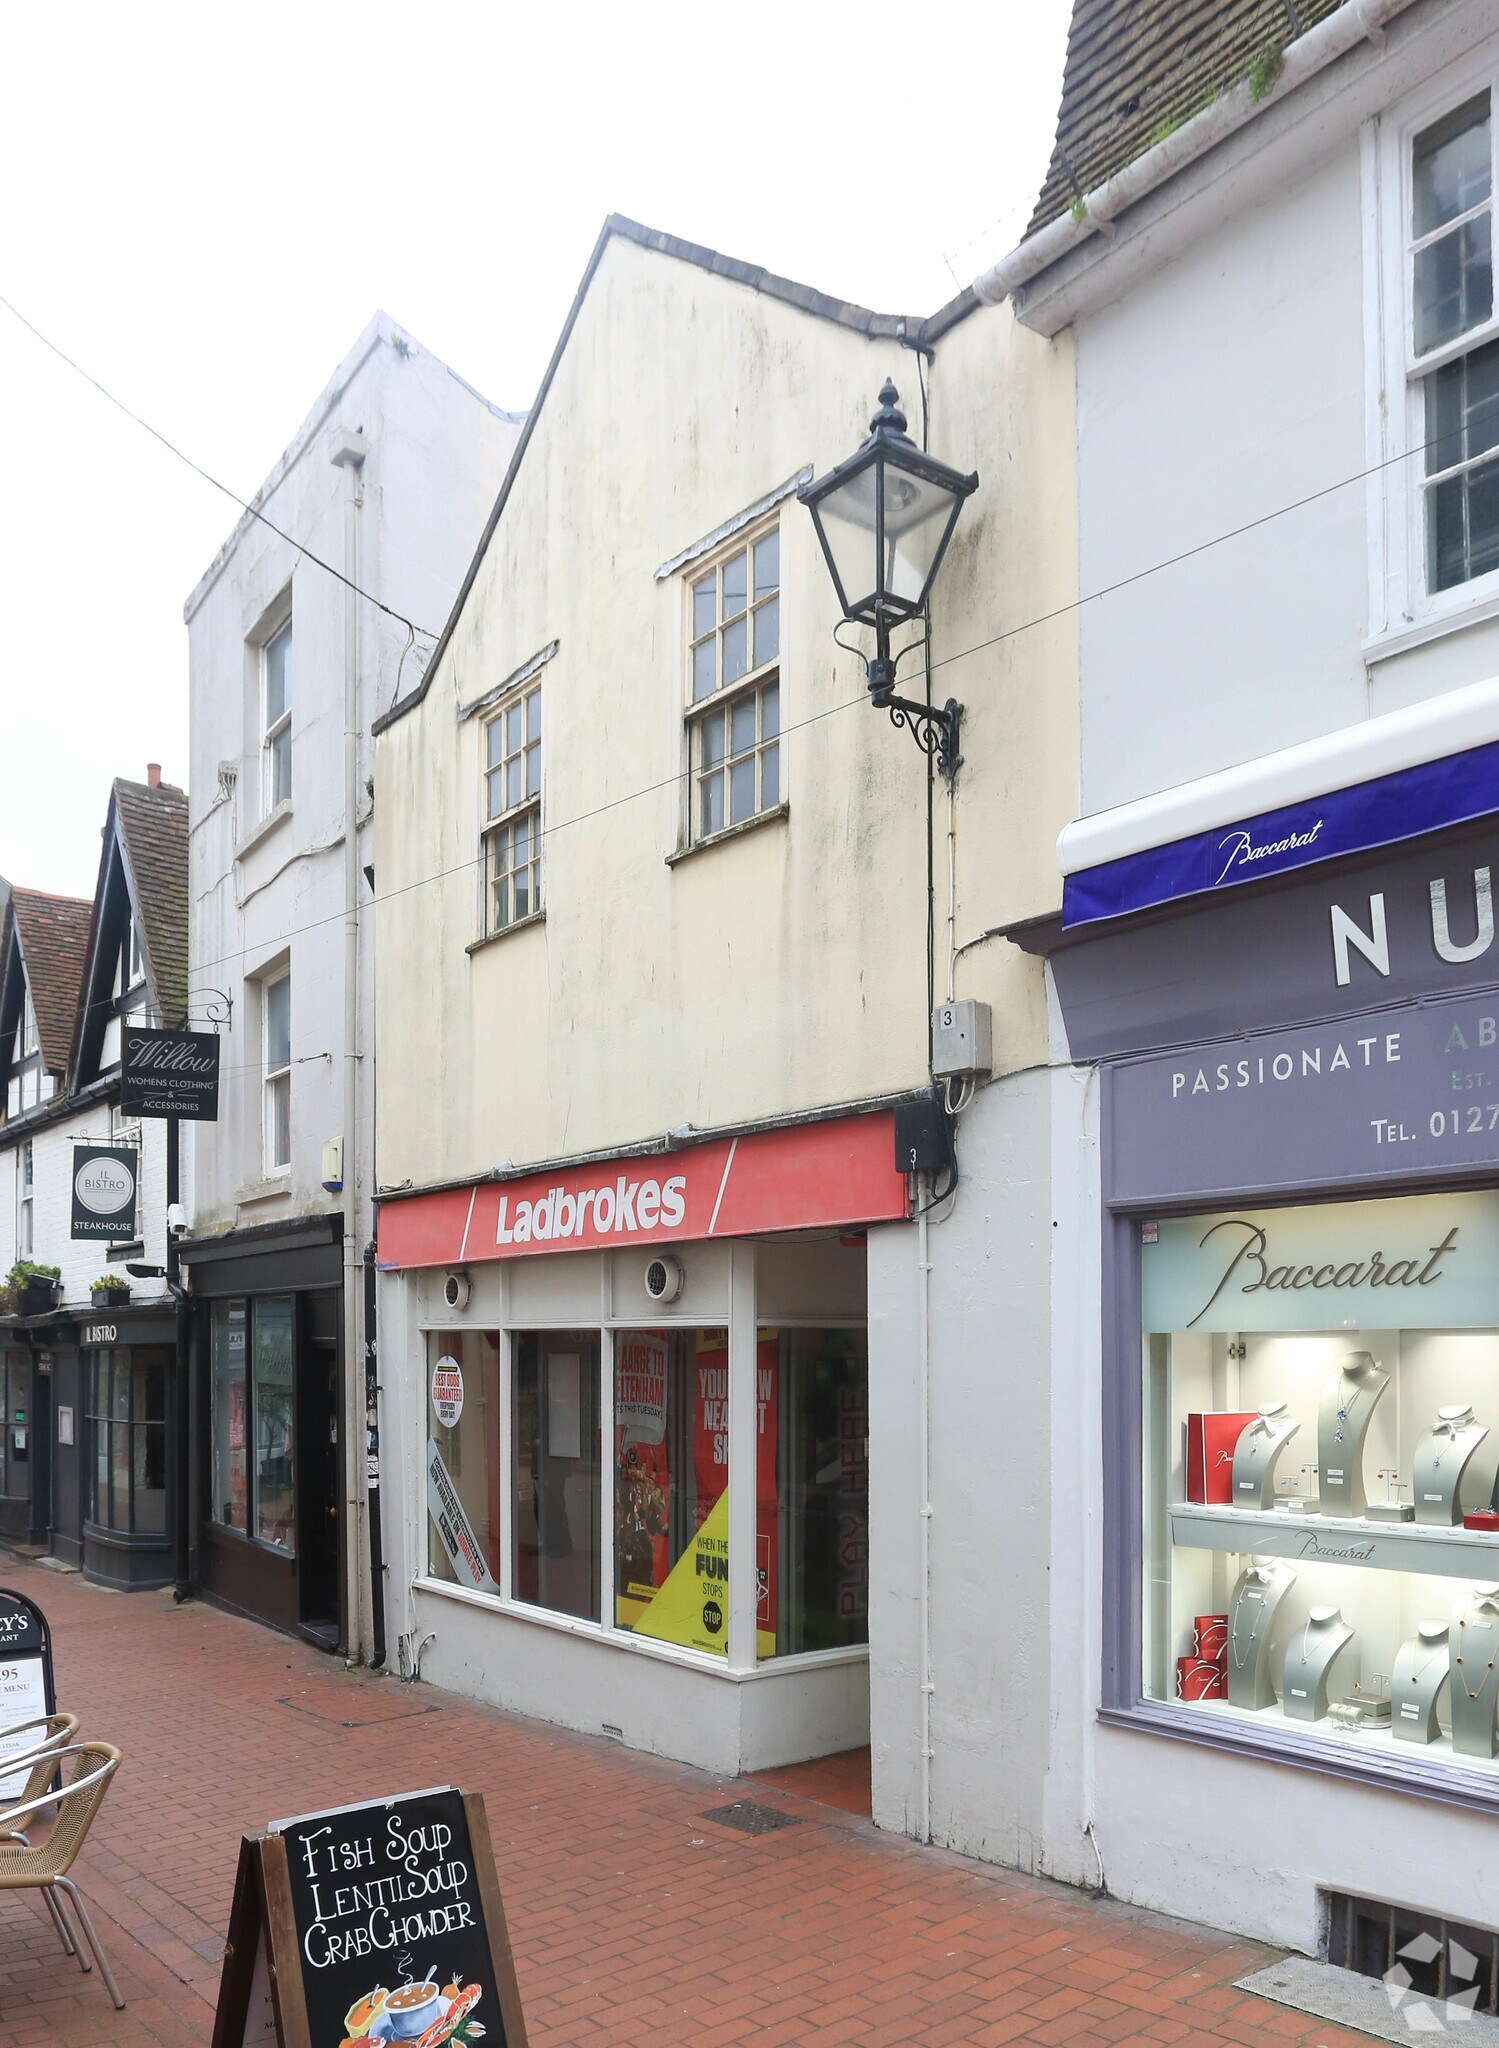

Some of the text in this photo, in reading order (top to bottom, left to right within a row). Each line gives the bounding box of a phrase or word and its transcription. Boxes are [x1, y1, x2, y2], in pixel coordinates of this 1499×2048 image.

[1215, 820, 1323, 885] Baccarat
[943, 1010, 952, 1026] 3
[128, 1038, 215, 1072] Willow
[1172, 1033, 1400, 1098] PASSIONATE
[127, 1077, 214, 1090] WOMENS CLOTHING
[142, 1101, 199, 1111] ACCESSORIES
[100, 1170, 110, 1179] IL
[84, 1179, 125, 1189] BISTRO
[496, 1175, 686, 1244] Ladbrokes
[74, 1221, 132, 1231] STEAKHOUSE
[1186, 1220, 1459, 1328] Baccarat
[92, 1325, 117, 1342] BISTRO
[653, 1348, 665, 1377] TO
[435, 1373, 460, 1388] BEST ODDS
[433, 1387, 463, 1402] GUARANTEED
[624, 1405, 636, 1414] THIS
[840, 1390, 866, 1495] HERE
[696, 1536, 728, 1553] WHEN THE
[1295, 1530, 1376, 1560] Baccarat
[695, 1553, 728, 1582] FUN
[840, 1513, 866, 1618] PLAY
[702, 1582, 723, 1599] STOPS
[703, 1609, 721, 1625] STOP
[4, 1683, 30, 1693] MENU
